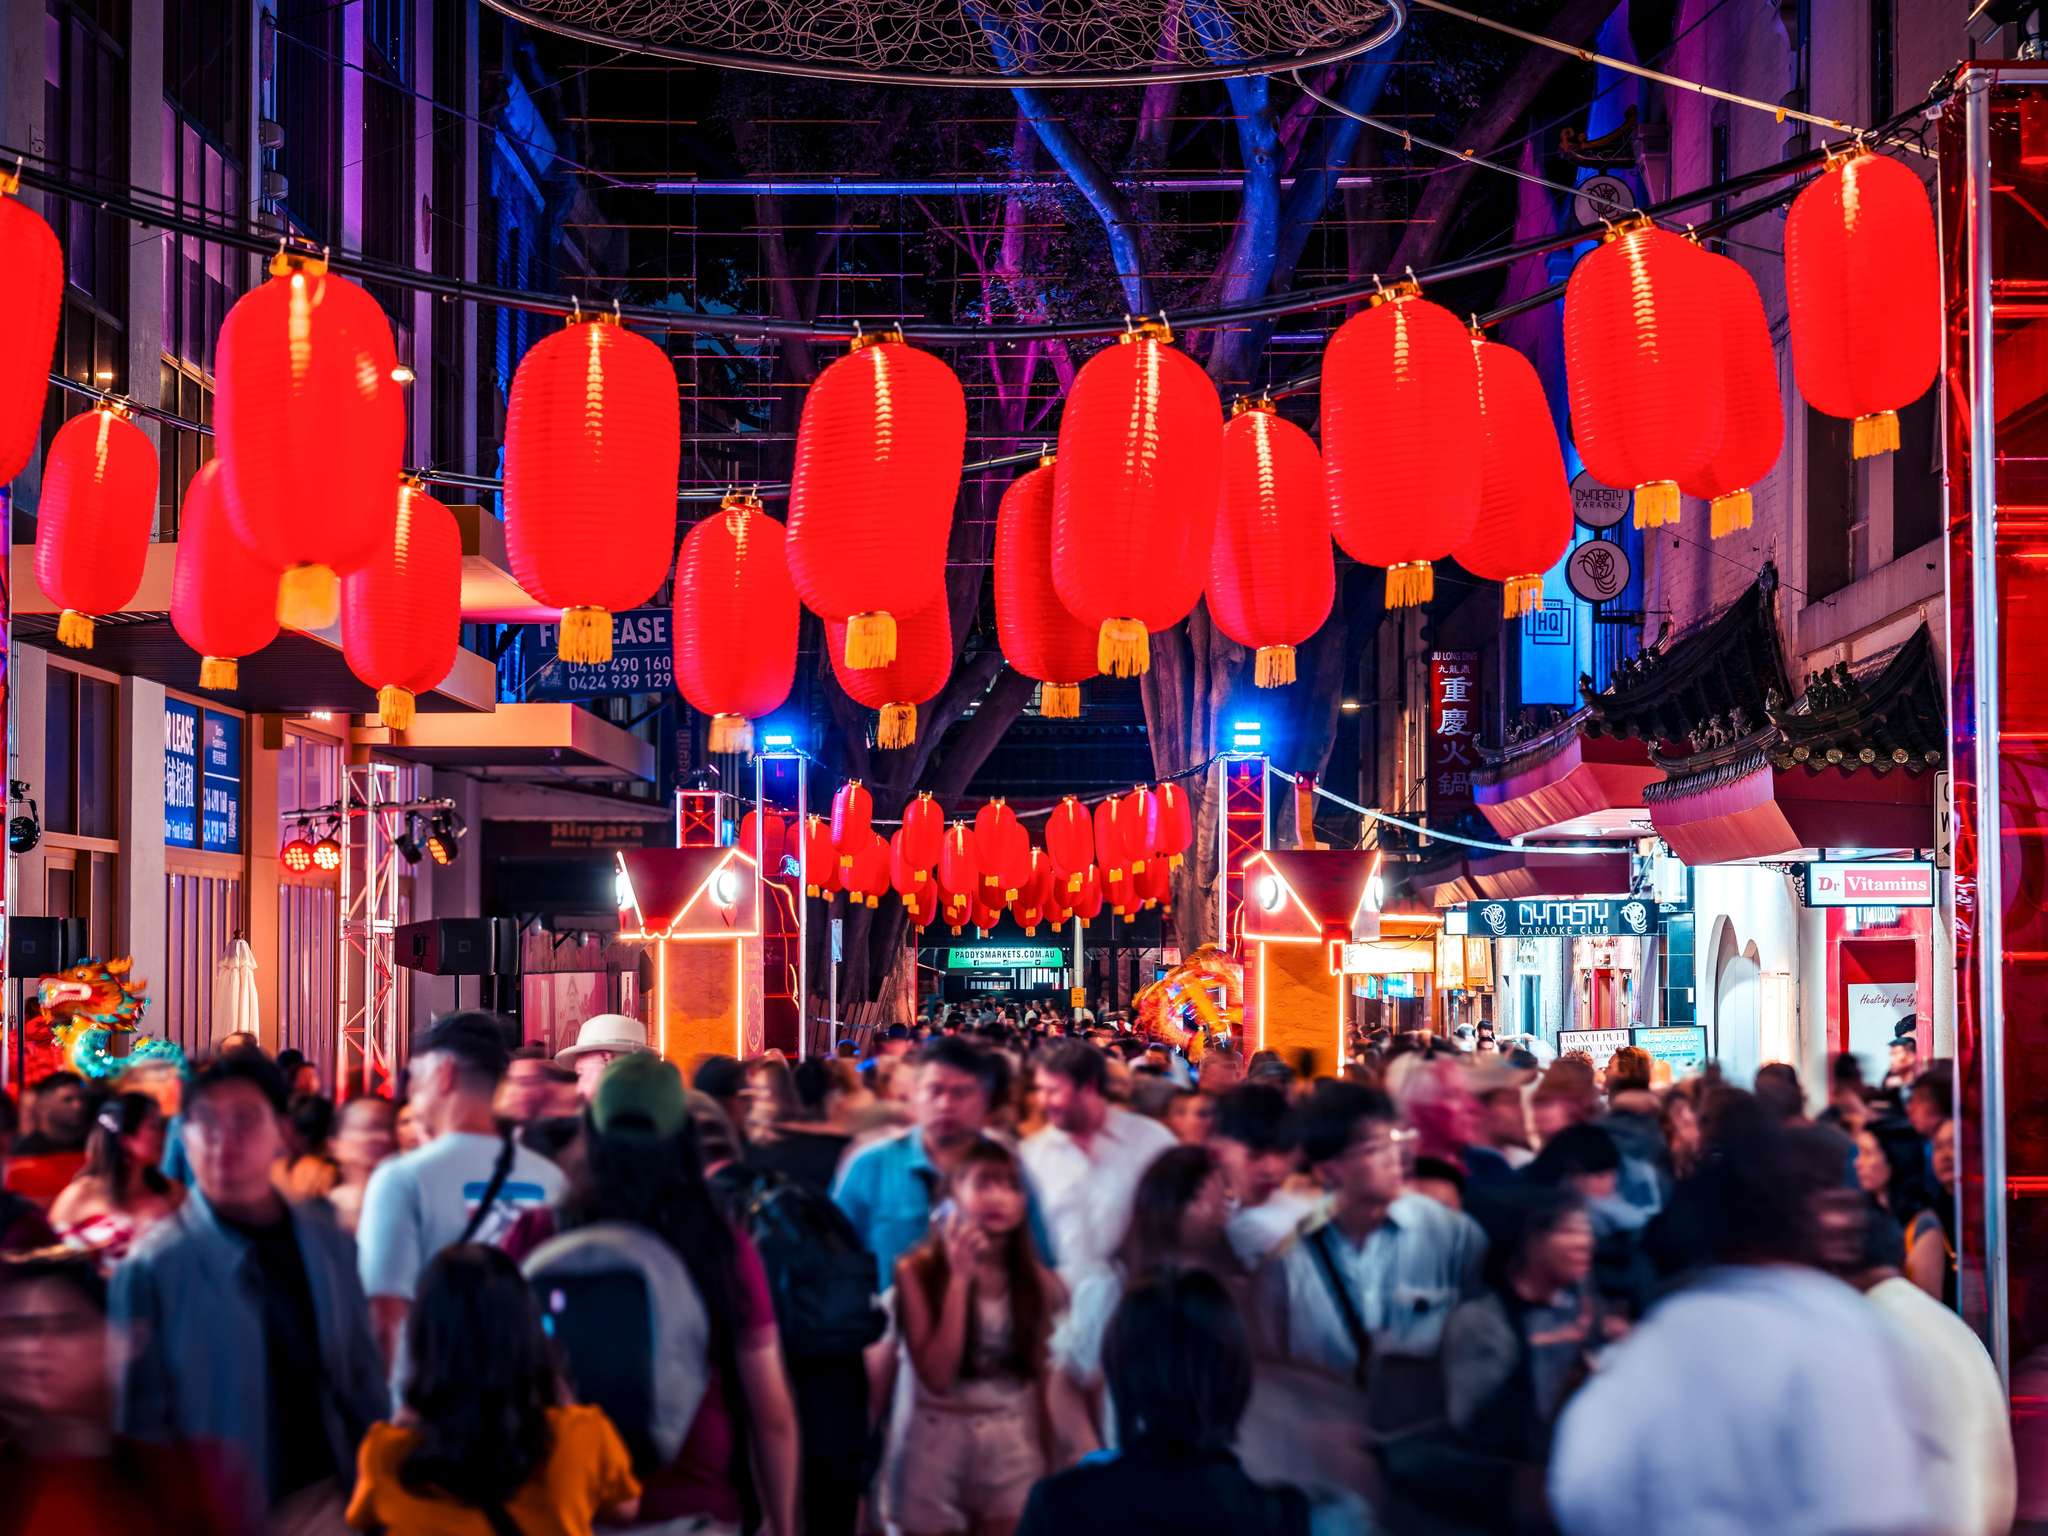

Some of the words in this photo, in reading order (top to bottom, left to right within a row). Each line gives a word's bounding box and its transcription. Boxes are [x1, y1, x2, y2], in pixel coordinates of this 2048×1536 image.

[1575, 488, 1624, 501] DYNASTY
[1575, 501, 1623, 509] KARAOKE
[1538, 612, 1559, 632] HQ
[612, 617, 666, 644] EASE
[611, 657, 639, 672] 490
[645, 656, 671, 671] 160
[1431, 651, 1441, 661] JIU
[569, 676, 607, 690] 0424
[611, 674, 640, 689] 939
[645, 673, 672, 688] 129
[172, 712, 194, 756] LEASE
[1436, 676, 1473, 796] 重慶火鍋
[1817, 876, 1840, 891] Dr
[1846, 876, 1928, 892] Vitamins
[1518, 902, 1609, 926] DYNASTY
[1519, 926, 1573, 935] KARAOKE
[1579, 926, 1609, 935] CLUB
[955, 949, 1055, 959] PADDYSMARKETS.COM.AU
[1860, 993, 1890, 1007] Healthy
